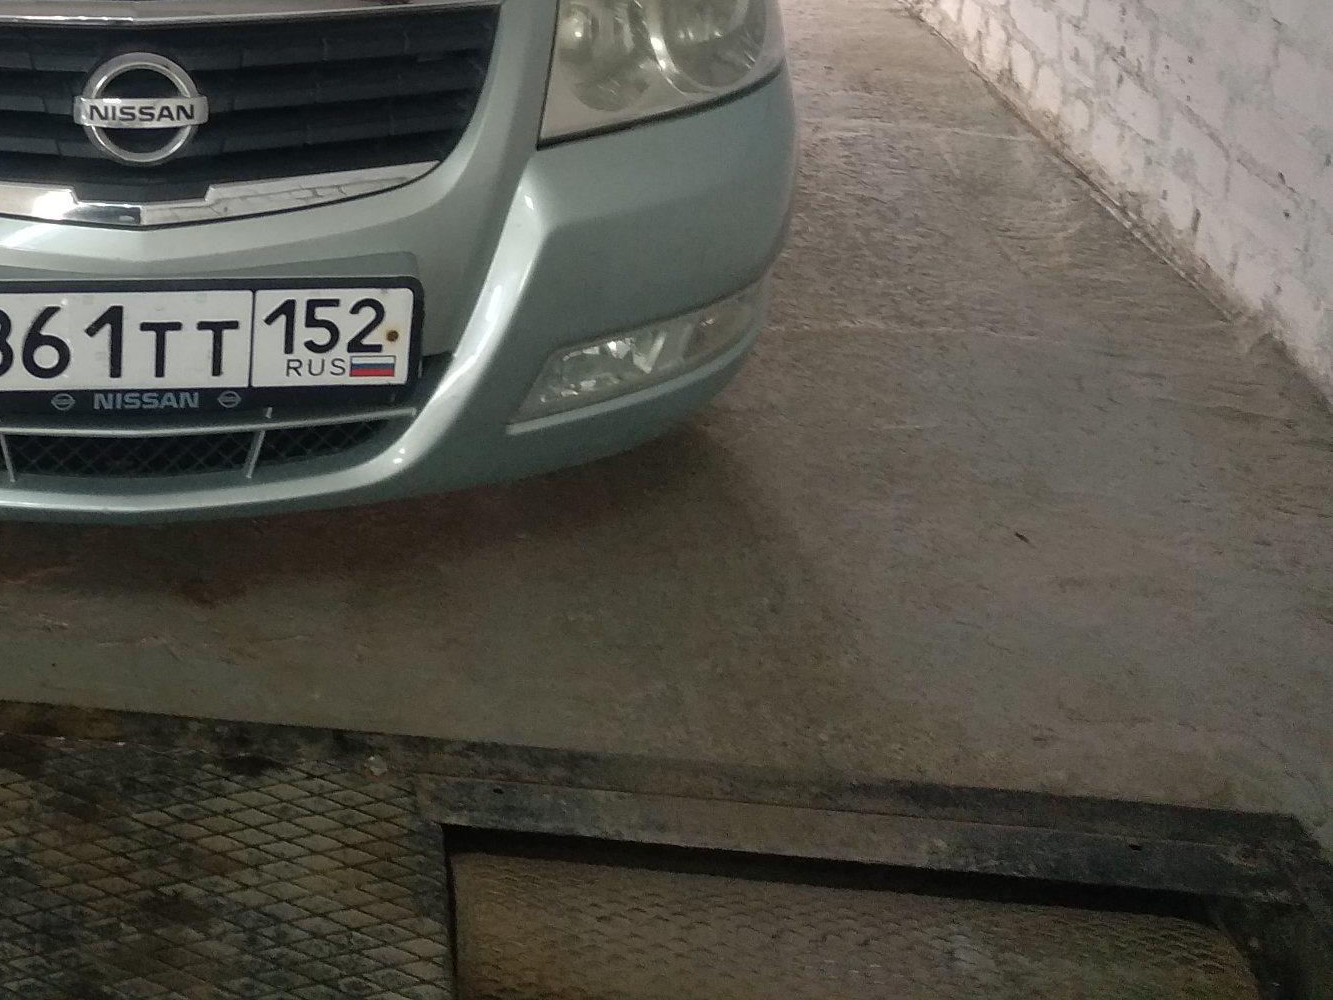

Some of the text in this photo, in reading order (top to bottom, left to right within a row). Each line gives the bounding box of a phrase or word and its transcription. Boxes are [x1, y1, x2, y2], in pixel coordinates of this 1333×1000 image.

[89, 104, 195, 122] NISSAN
[262, 297, 387, 356] 152
[284, 356, 347, 378] RUS
[93, 391, 200, 410] NISSAN
